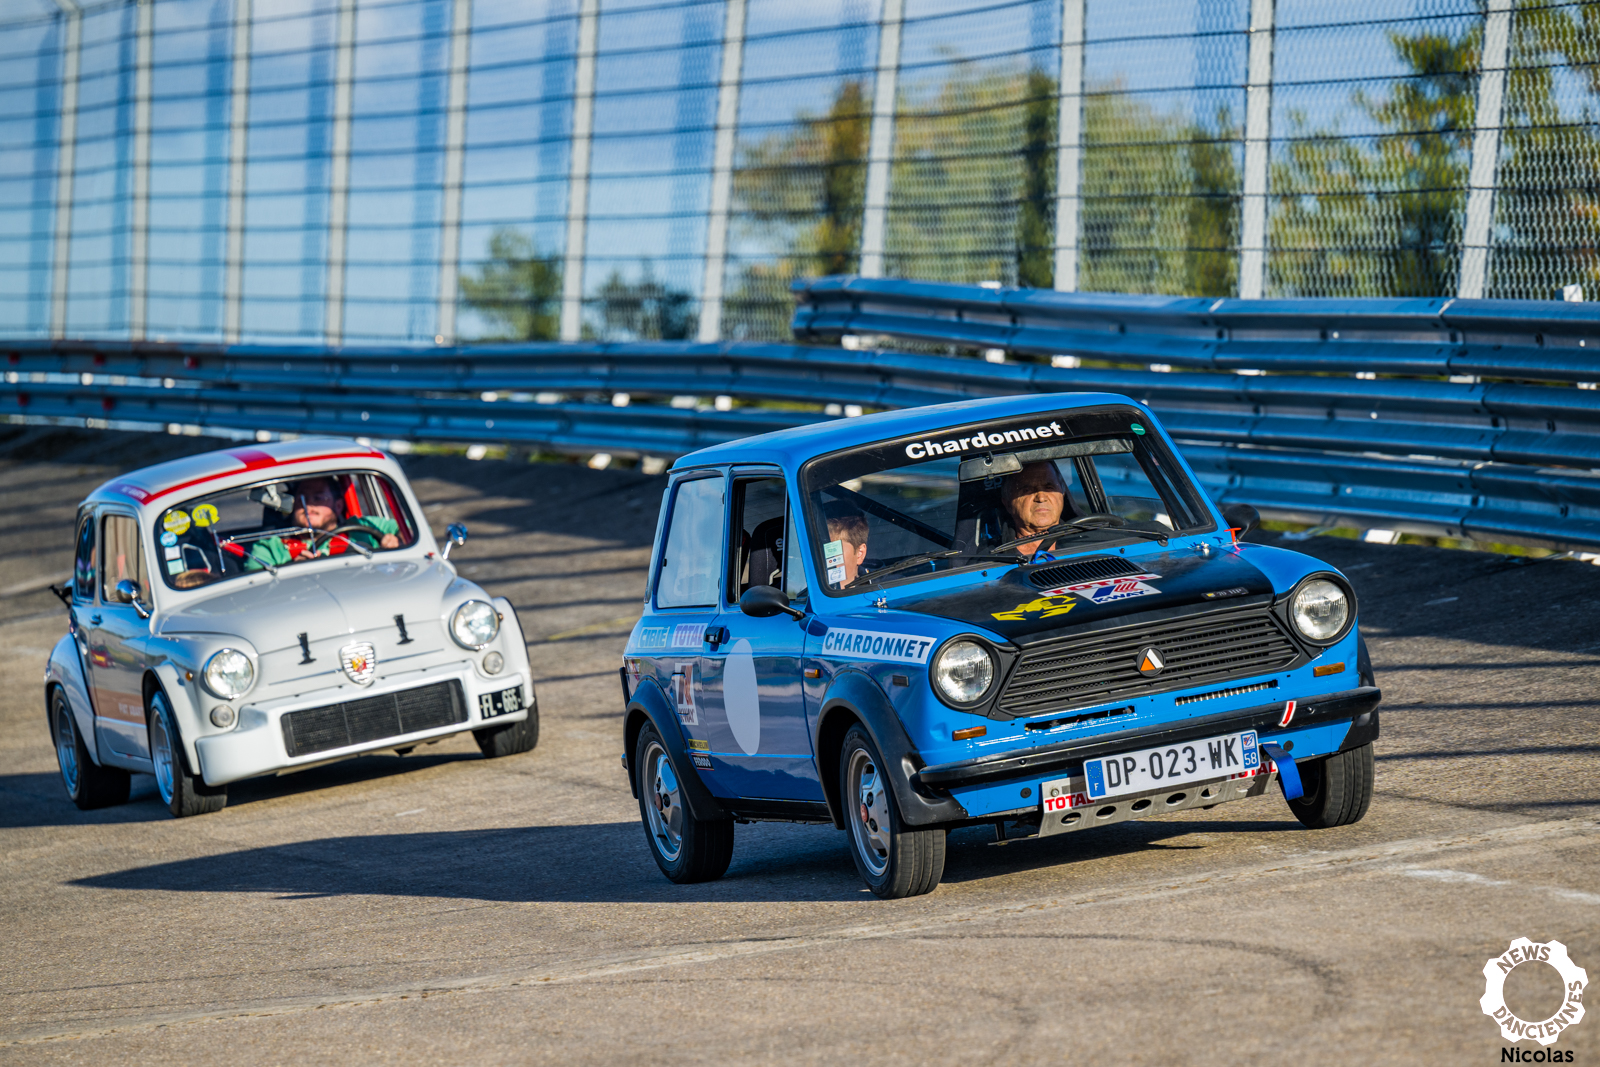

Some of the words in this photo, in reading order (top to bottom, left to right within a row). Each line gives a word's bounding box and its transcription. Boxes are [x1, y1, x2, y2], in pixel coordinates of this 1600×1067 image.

[905, 421, 1065, 459] Chardonnet
[1043, 575, 1158, 595] TOTAL
[674, 624, 704, 646] TOTAL
[824, 631, 931, 659] CHARDONNET
[1093, 782, 1100, 791] F
[1105, 736, 1240, 788] DP-023-WK
[1243, 751, 1258, 766] 58
[1044, 792, 1096, 812] TOTAL
